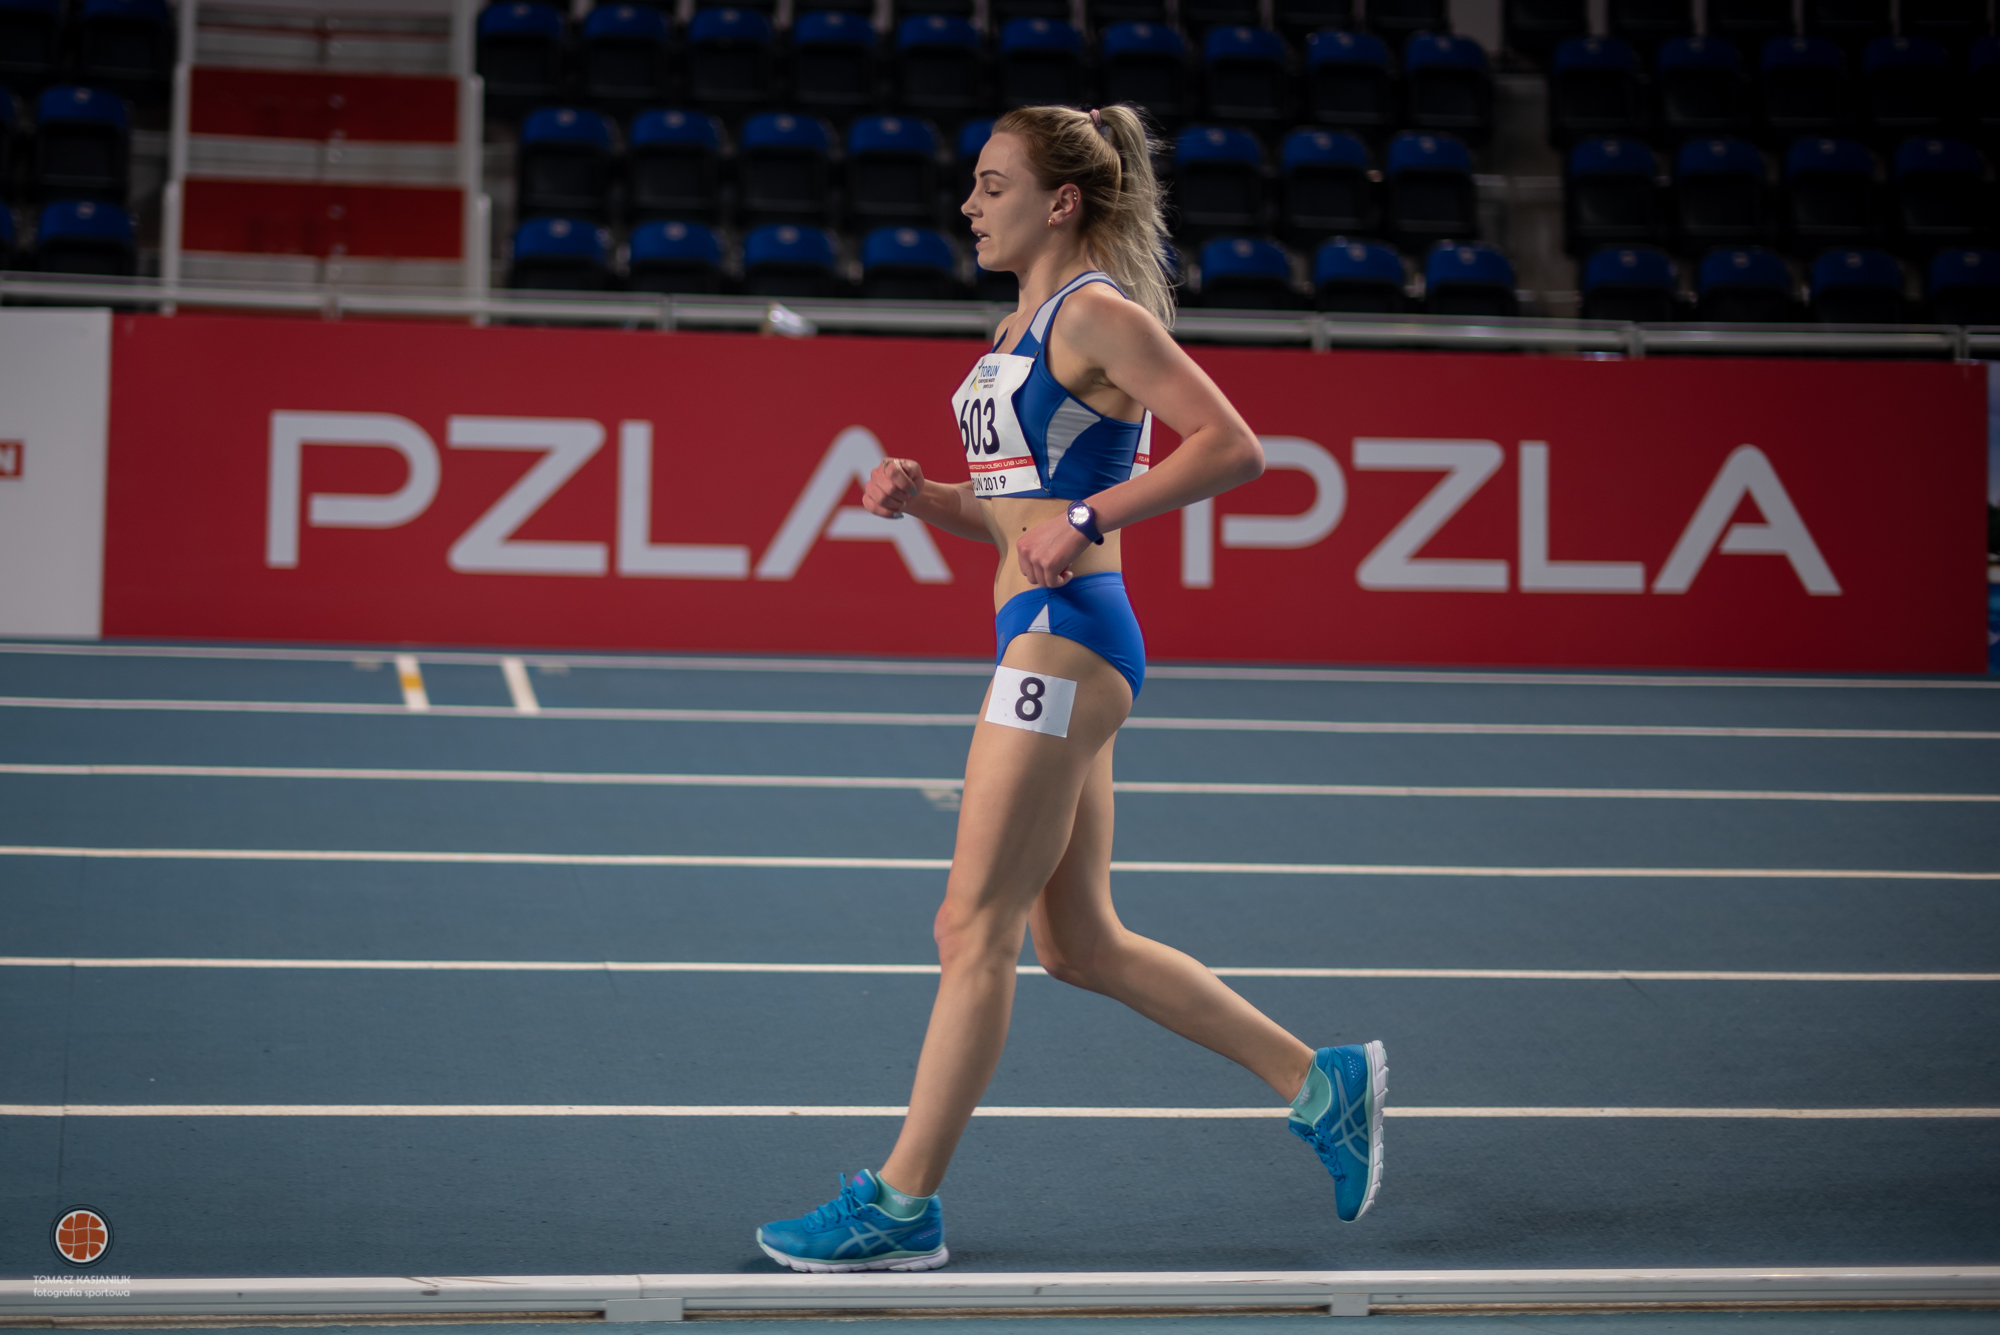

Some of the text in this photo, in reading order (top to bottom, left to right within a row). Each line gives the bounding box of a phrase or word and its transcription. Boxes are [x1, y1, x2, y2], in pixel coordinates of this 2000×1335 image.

[960, 397, 1000, 455] 603
[266, 409, 953, 583] PZLA
[984, 475, 1006, 491] 2019
[1180, 435, 1843, 597] PZLA
[1015, 677, 1046, 722] 8
